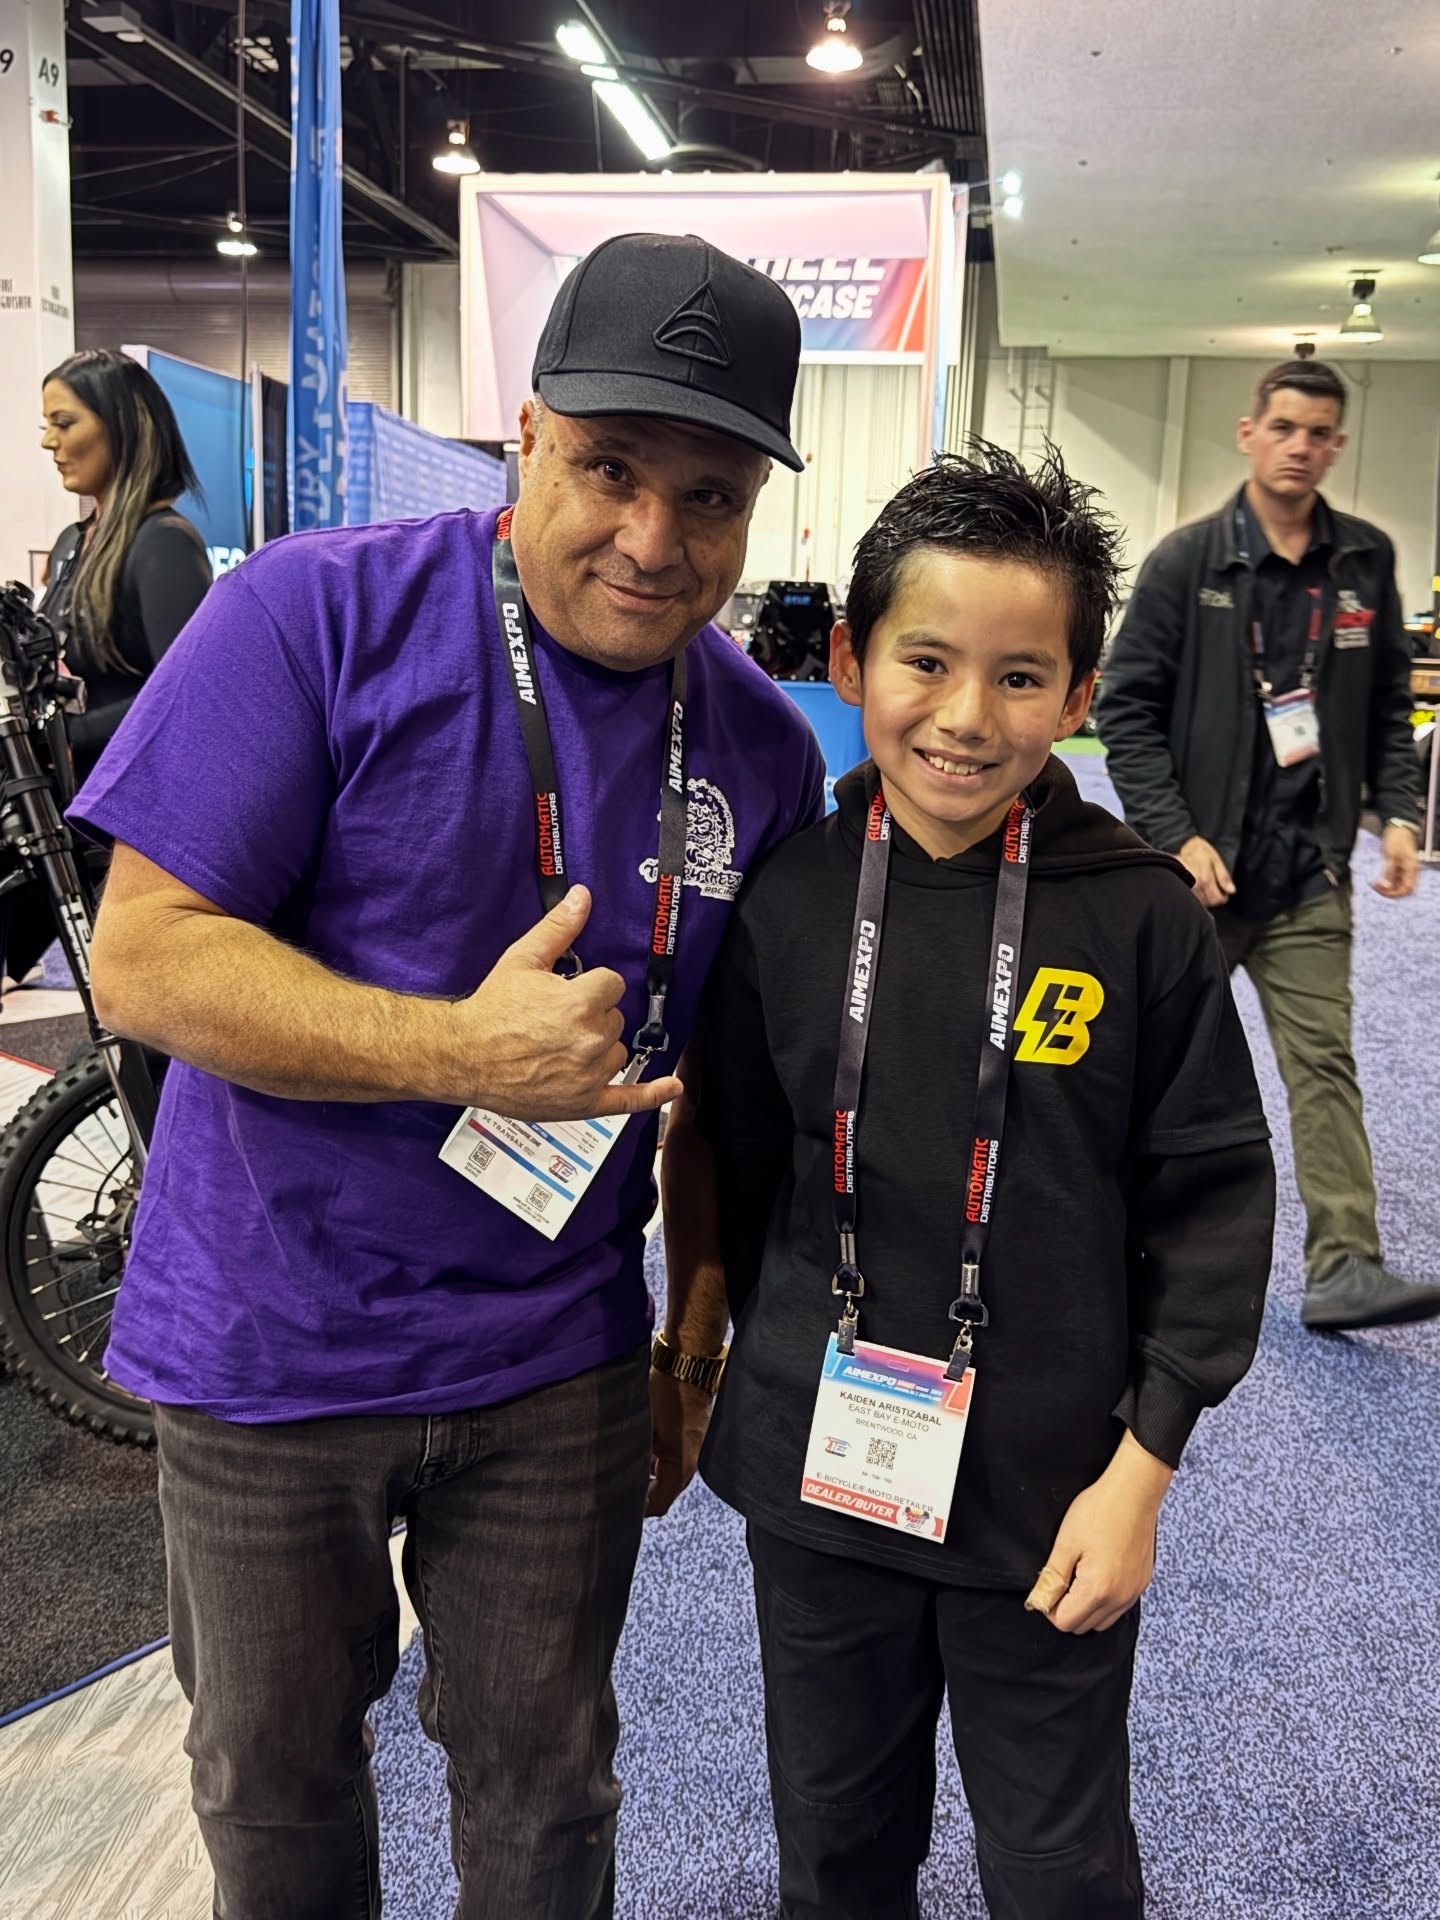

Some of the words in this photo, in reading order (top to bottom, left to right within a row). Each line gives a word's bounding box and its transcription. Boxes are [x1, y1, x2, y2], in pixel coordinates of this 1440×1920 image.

[38, 57, 60, 88] A9
[536, 792, 556, 876] AUTOMATIC
[548, 792, 564, 875] DISTRIBUTORS
[652, 873, 673, 955] AUTOMATIC
[666, 875, 681, 955] DISTRIBUTORS
[492, 1121, 524, 1149] TRANSAX
[834, 1110, 848, 1194] AUTOMATIC
[846, 1110, 856, 1194] DISTRIBUTORS
[965, 1137, 990, 1223] AUTOMATIC
[979, 1139, 999, 1223] DISTRIBUTORS
[839, 1390, 877, 1407] KAIDEN
[878, 1401, 942, 1426] ARISTIZABAL
[848, 1403, 872, 1416] EAST
[873, 1410, 892, 1421] BAY
[893, 1416, 930, 1432] E-MOTO
[906, 1432, 917, 1441] CA
[805, 1483, 895, 1519] DEALER/BUYER
[893, 1495, 934, 1513] RETAILER
